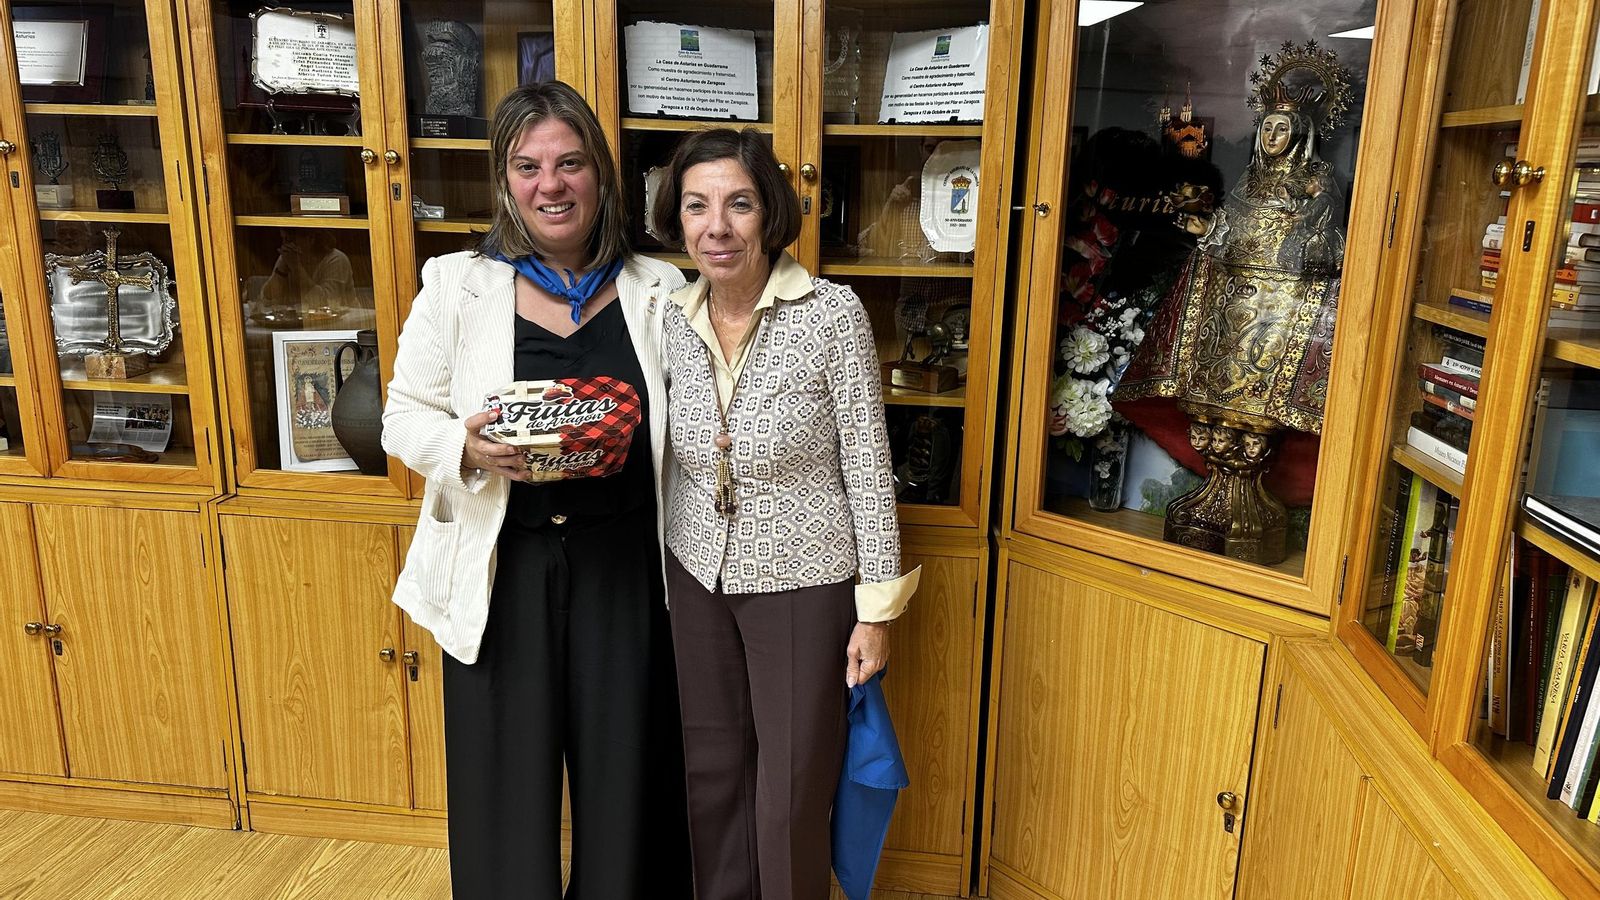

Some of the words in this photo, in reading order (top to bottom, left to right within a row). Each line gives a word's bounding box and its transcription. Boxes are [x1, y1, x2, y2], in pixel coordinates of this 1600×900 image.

[508, 398, 615, 423] Frutas
[526, 420, 544, 428] de
[525, 450, 602, 466] Frutas
[1382, 584, 1388, 595] UN
[1560, 632, 1569, 657] VARIA
